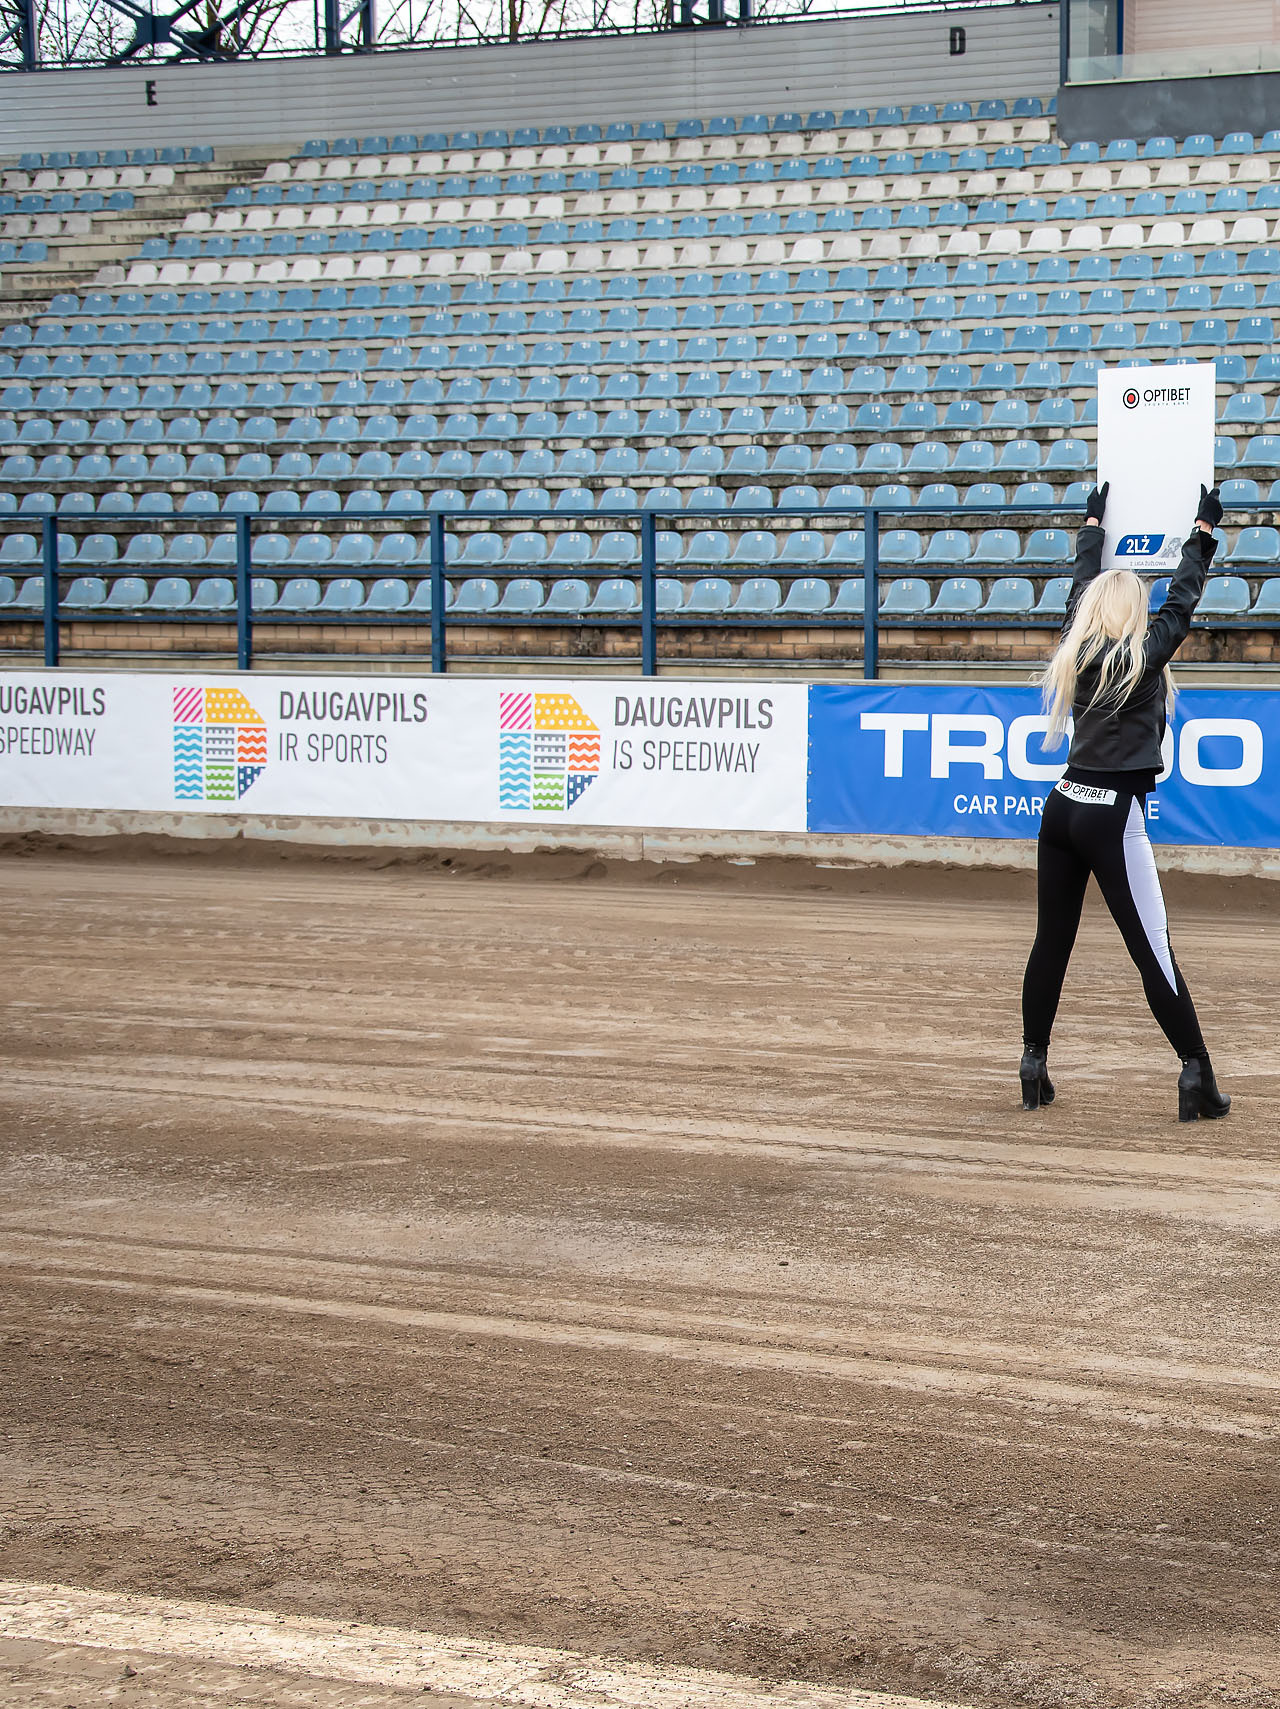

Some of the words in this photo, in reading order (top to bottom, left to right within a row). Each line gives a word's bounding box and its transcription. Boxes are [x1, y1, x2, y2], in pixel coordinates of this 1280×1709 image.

[950, 26, 966, 56] D
[145, 80, 158, 106] E
[1143, 387, 1191, 402] OPTIBET
[1126, 535, 1151, 554] 2LŻ
[280, 691, 428, 723] DAUGAVPILS
[614, 696, 774, 730] DAUGAVPILS
[279, 732, 299, 762] IR
[307, 733, 388, 764] SPORTS
[613, 739, 633, 770] IS
[643, 740, 760, 773] SPEEDWAY
[860, 713, 1263, 787] TROO
[953, 795, 998, 815] CAR
[1072, 785, 1109, 798] OPTIBET
